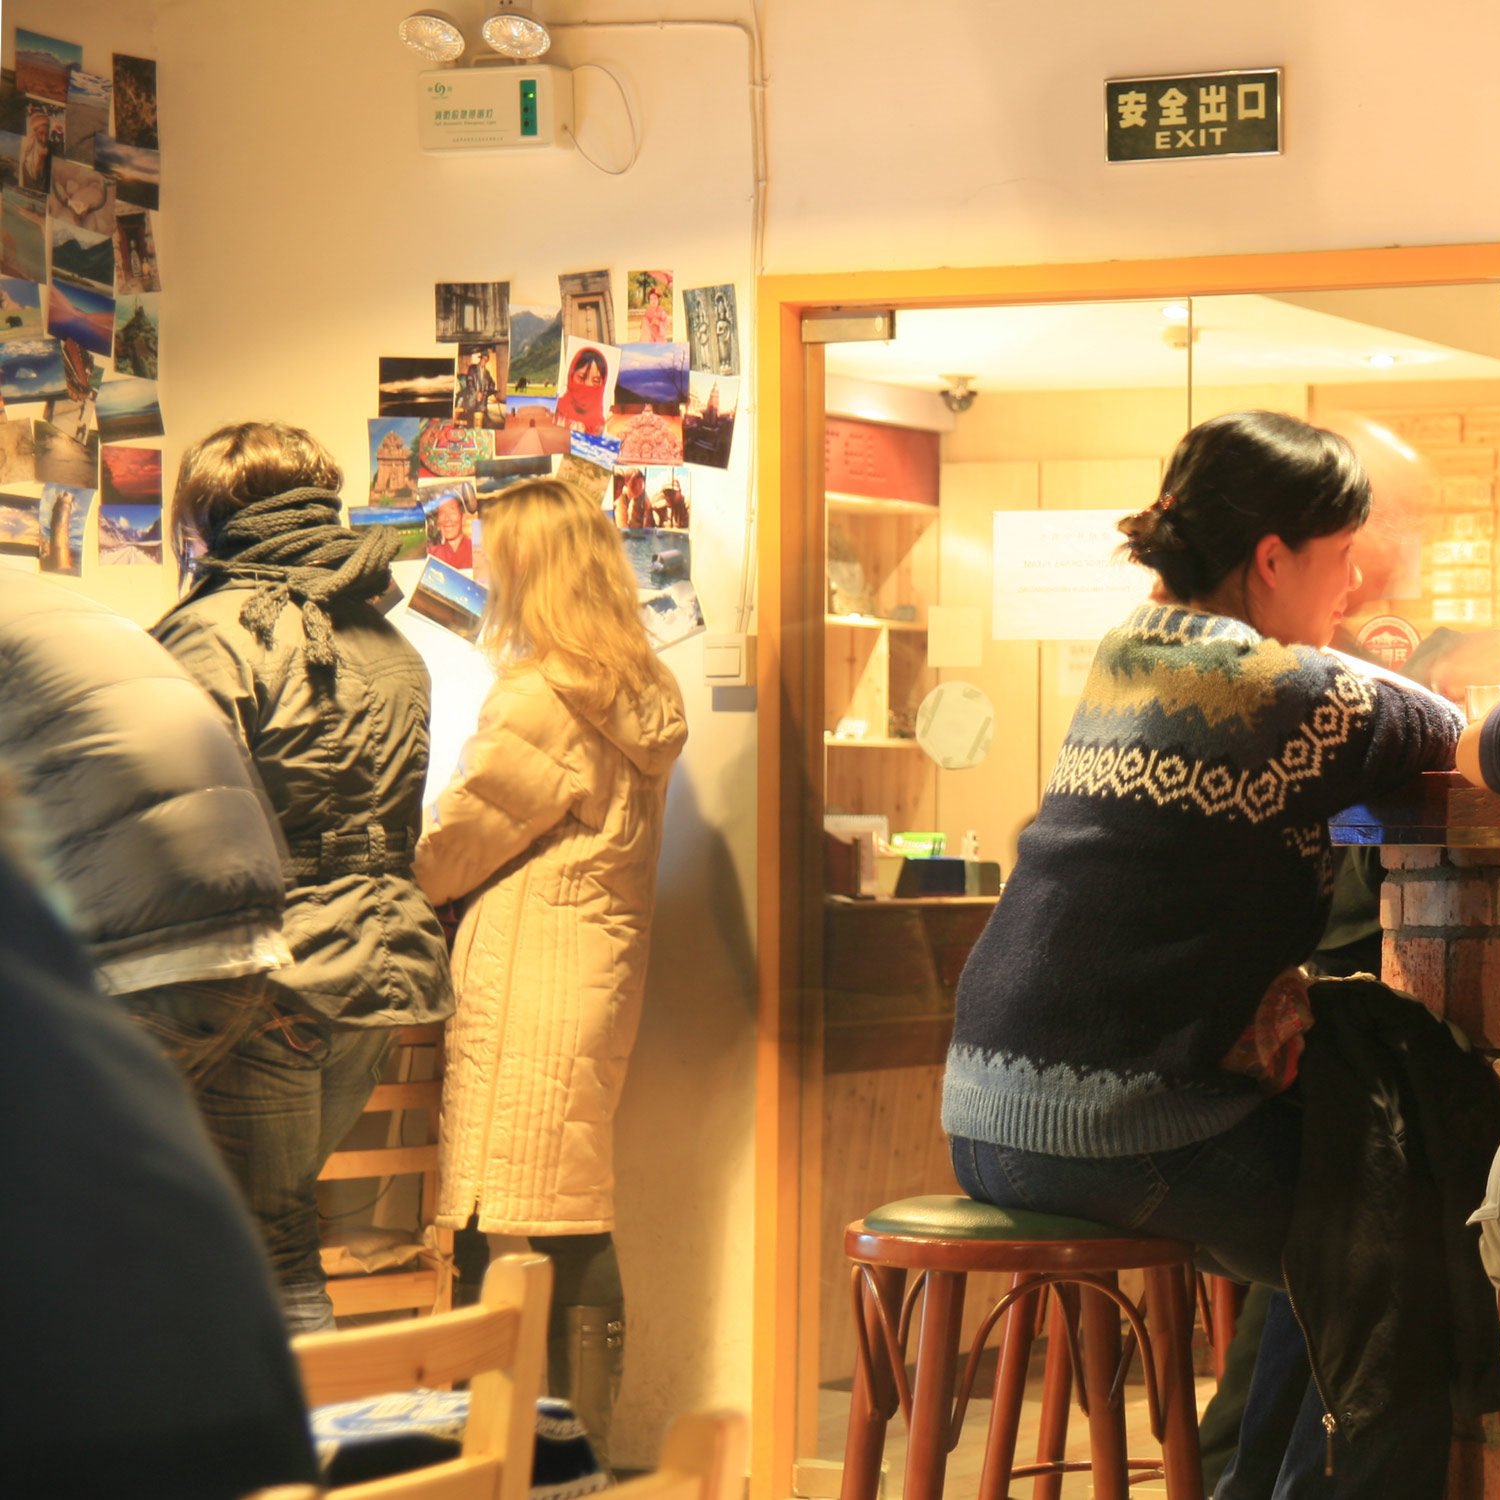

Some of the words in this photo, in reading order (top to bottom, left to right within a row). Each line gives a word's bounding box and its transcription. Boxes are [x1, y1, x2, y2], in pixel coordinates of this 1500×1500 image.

[1118, 83, 1266, 128] 安全出口
[1155, 127, 1227, 149] EXIT
